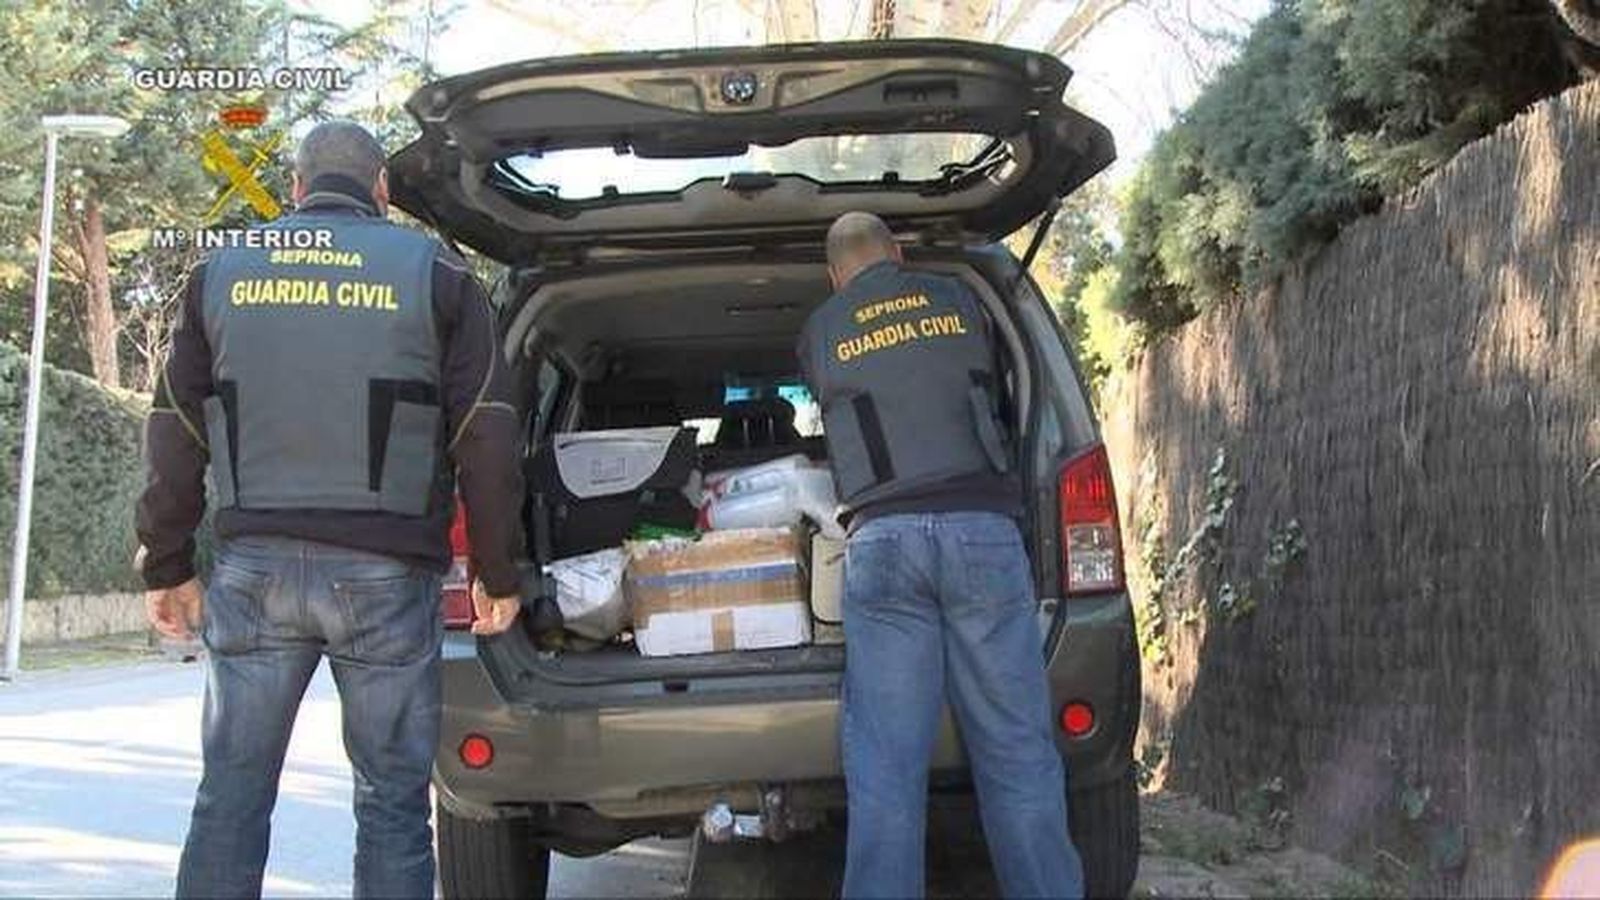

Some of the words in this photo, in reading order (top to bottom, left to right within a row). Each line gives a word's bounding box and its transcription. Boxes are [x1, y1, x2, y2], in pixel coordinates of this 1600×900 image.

[270, 249, 363, 268] SEPRONA
[231, 279, 329, 307] GUARDIA
[336, 283, 399, 311] CIVIL
[855, 294, 930, 323] SEPRONA
[836, 322, 918, 362] GUARDIA
[920, 315, 966, 337] CIVIL
